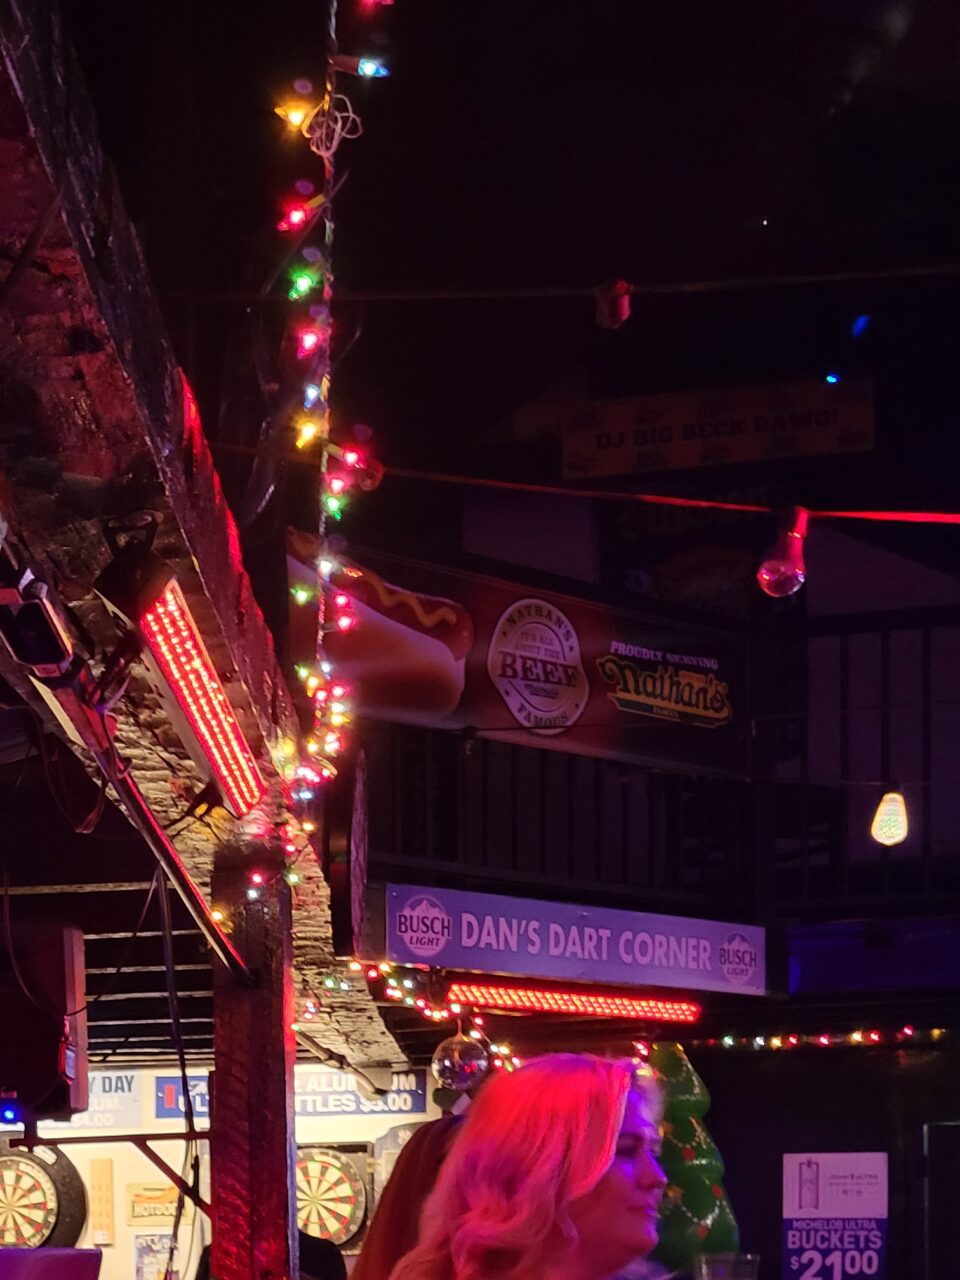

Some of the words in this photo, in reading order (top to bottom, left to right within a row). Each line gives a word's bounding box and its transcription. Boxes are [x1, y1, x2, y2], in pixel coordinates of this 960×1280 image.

[595, 431, 624, 449] DJ
[633, 426, 674, 447] BIG
[506, 605, 573, 642] NATHAN'S
[610, 640, 663, 662] PROUDLY
[665, 652, 719, 671] SERVING
[498, 651, 578, 688] BEEF
[597, 657, 729, 716] Nathan's
[517, 703, 569, 728] FAMOUS
[398, 914, 451, 938] BUSCH
[409, 935, 441, 948] LIGHT
[461, 912, 541, 956] DAN'S
[548, 923, 612, 961] DART
[618, 930, 713, 970] CORNER
[719, 948, 758, 968] BUSCH
[726, 965, 750, 978] LIGHT
[102, 1075, 136, 1094] DAY
[792, 1219, 843, 1230] MICHELOB
[845, 1219, 877, 1230] ULTRA
[787, 1230, 882, 1250] BUCKETS
